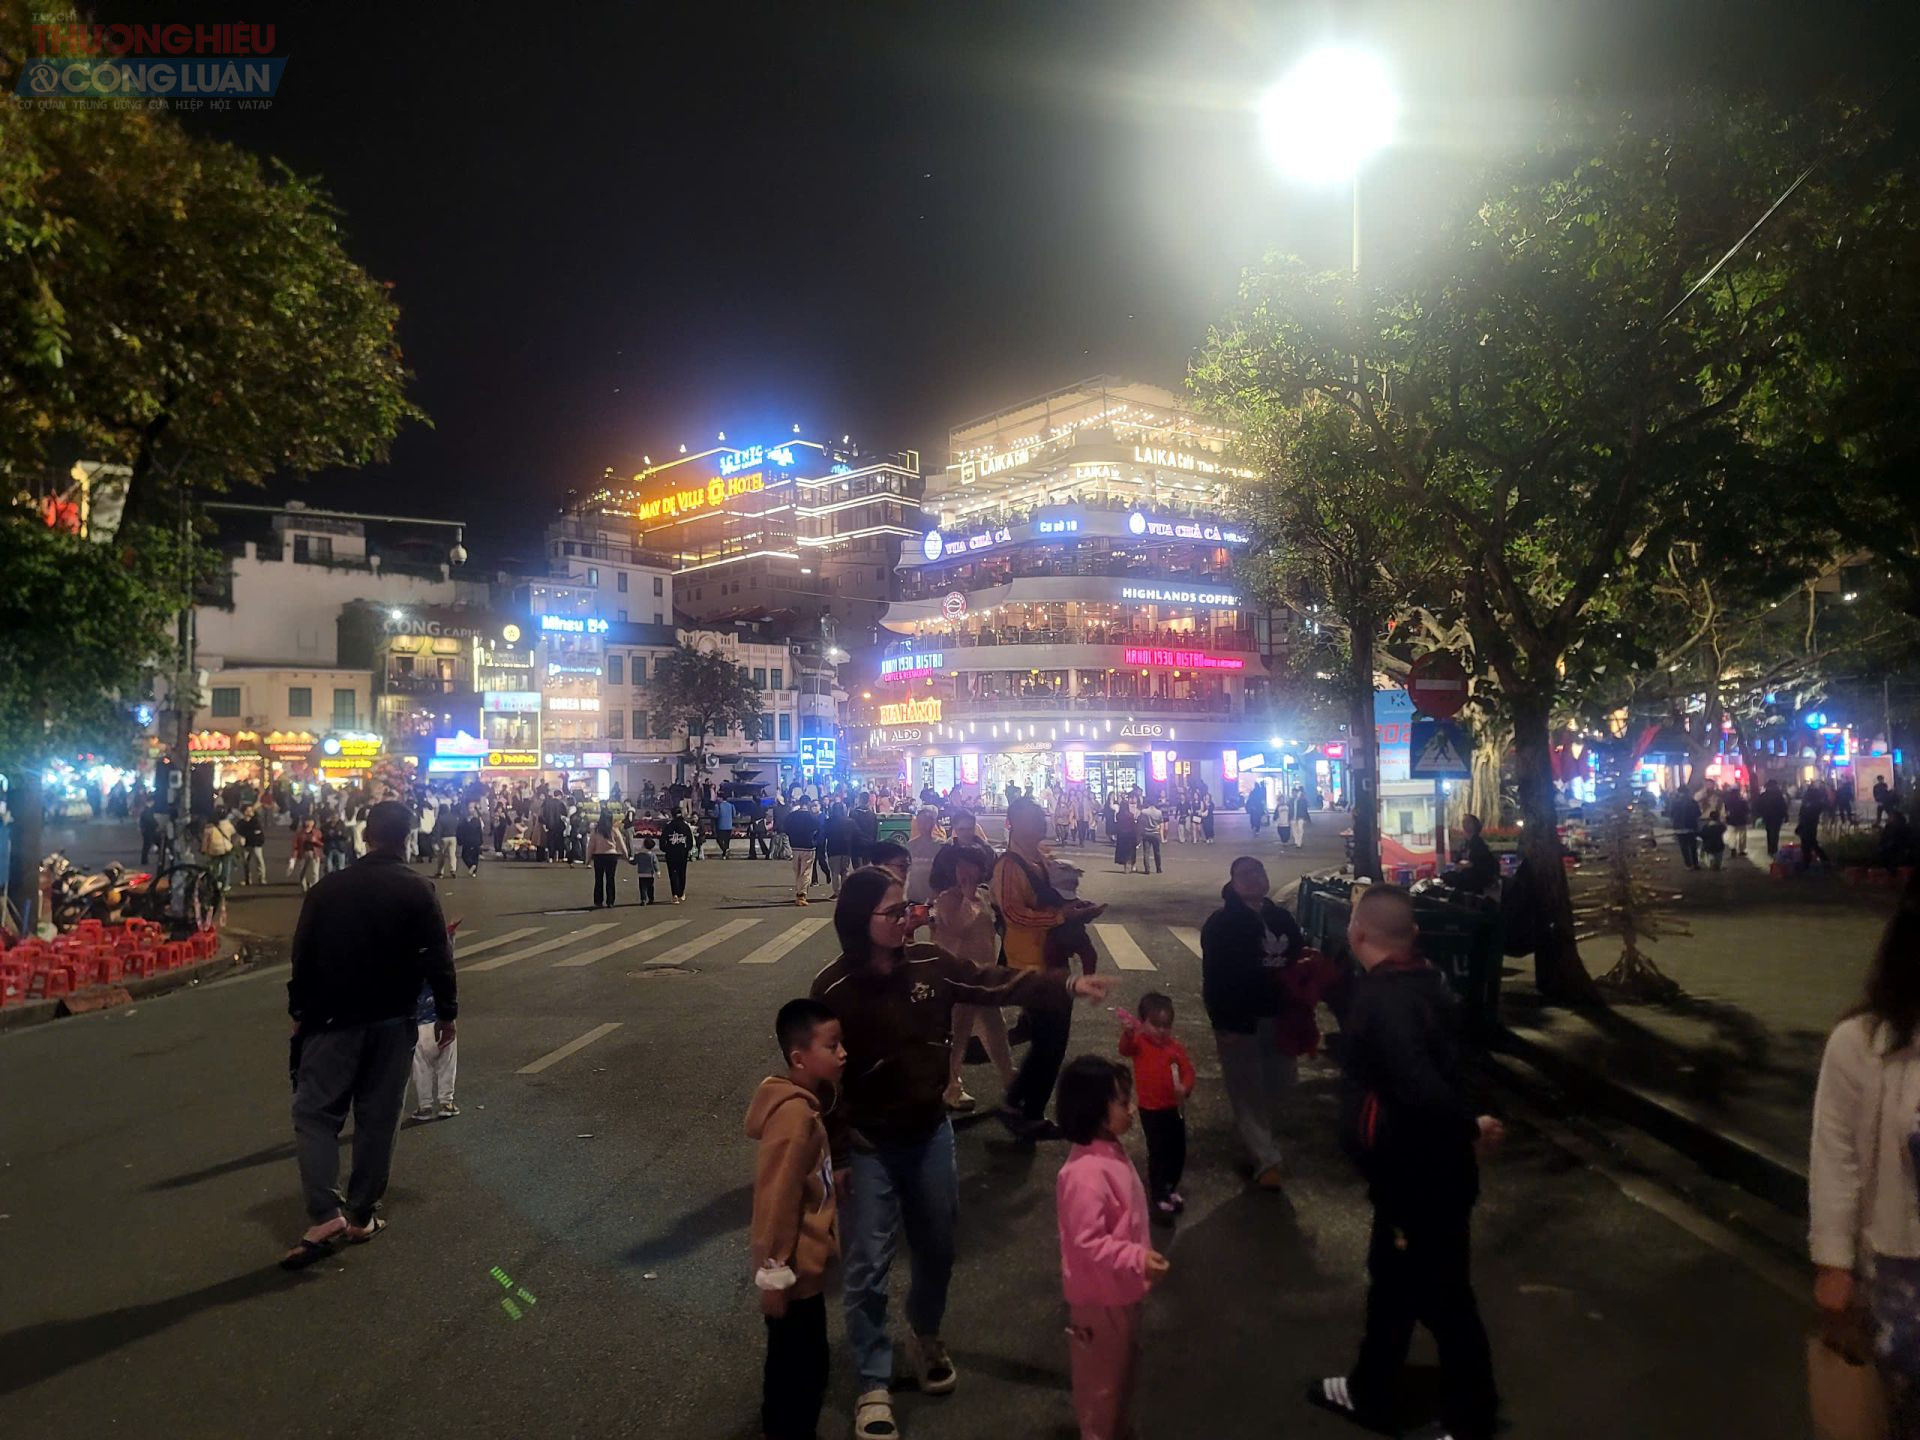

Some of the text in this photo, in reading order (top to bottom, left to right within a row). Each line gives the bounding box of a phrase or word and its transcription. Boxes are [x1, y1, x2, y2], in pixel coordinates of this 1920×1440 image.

[1135, 446, 1176, 468] LAIKA
[980, 453, 1015, 477] LAIKA
[662, 495, 676, 514] DE
[677, 488, 704, 511] VILLE
[728, 472, 764, 497] HOTEL
[1147, 522, 1174, 536] VUA
[945, 540, 967, 555] VUA
[1122, 588, 1197, 603] HIGHLANDS
[916, 654, 943, 669] BISTRO
[1153, 651, 1174, 666] 1930
[1176, 652, 1204, 667] BISTRO
[891, 728, 922, 742] ALDO
[1120, 724, 1163, 737] ALDO
